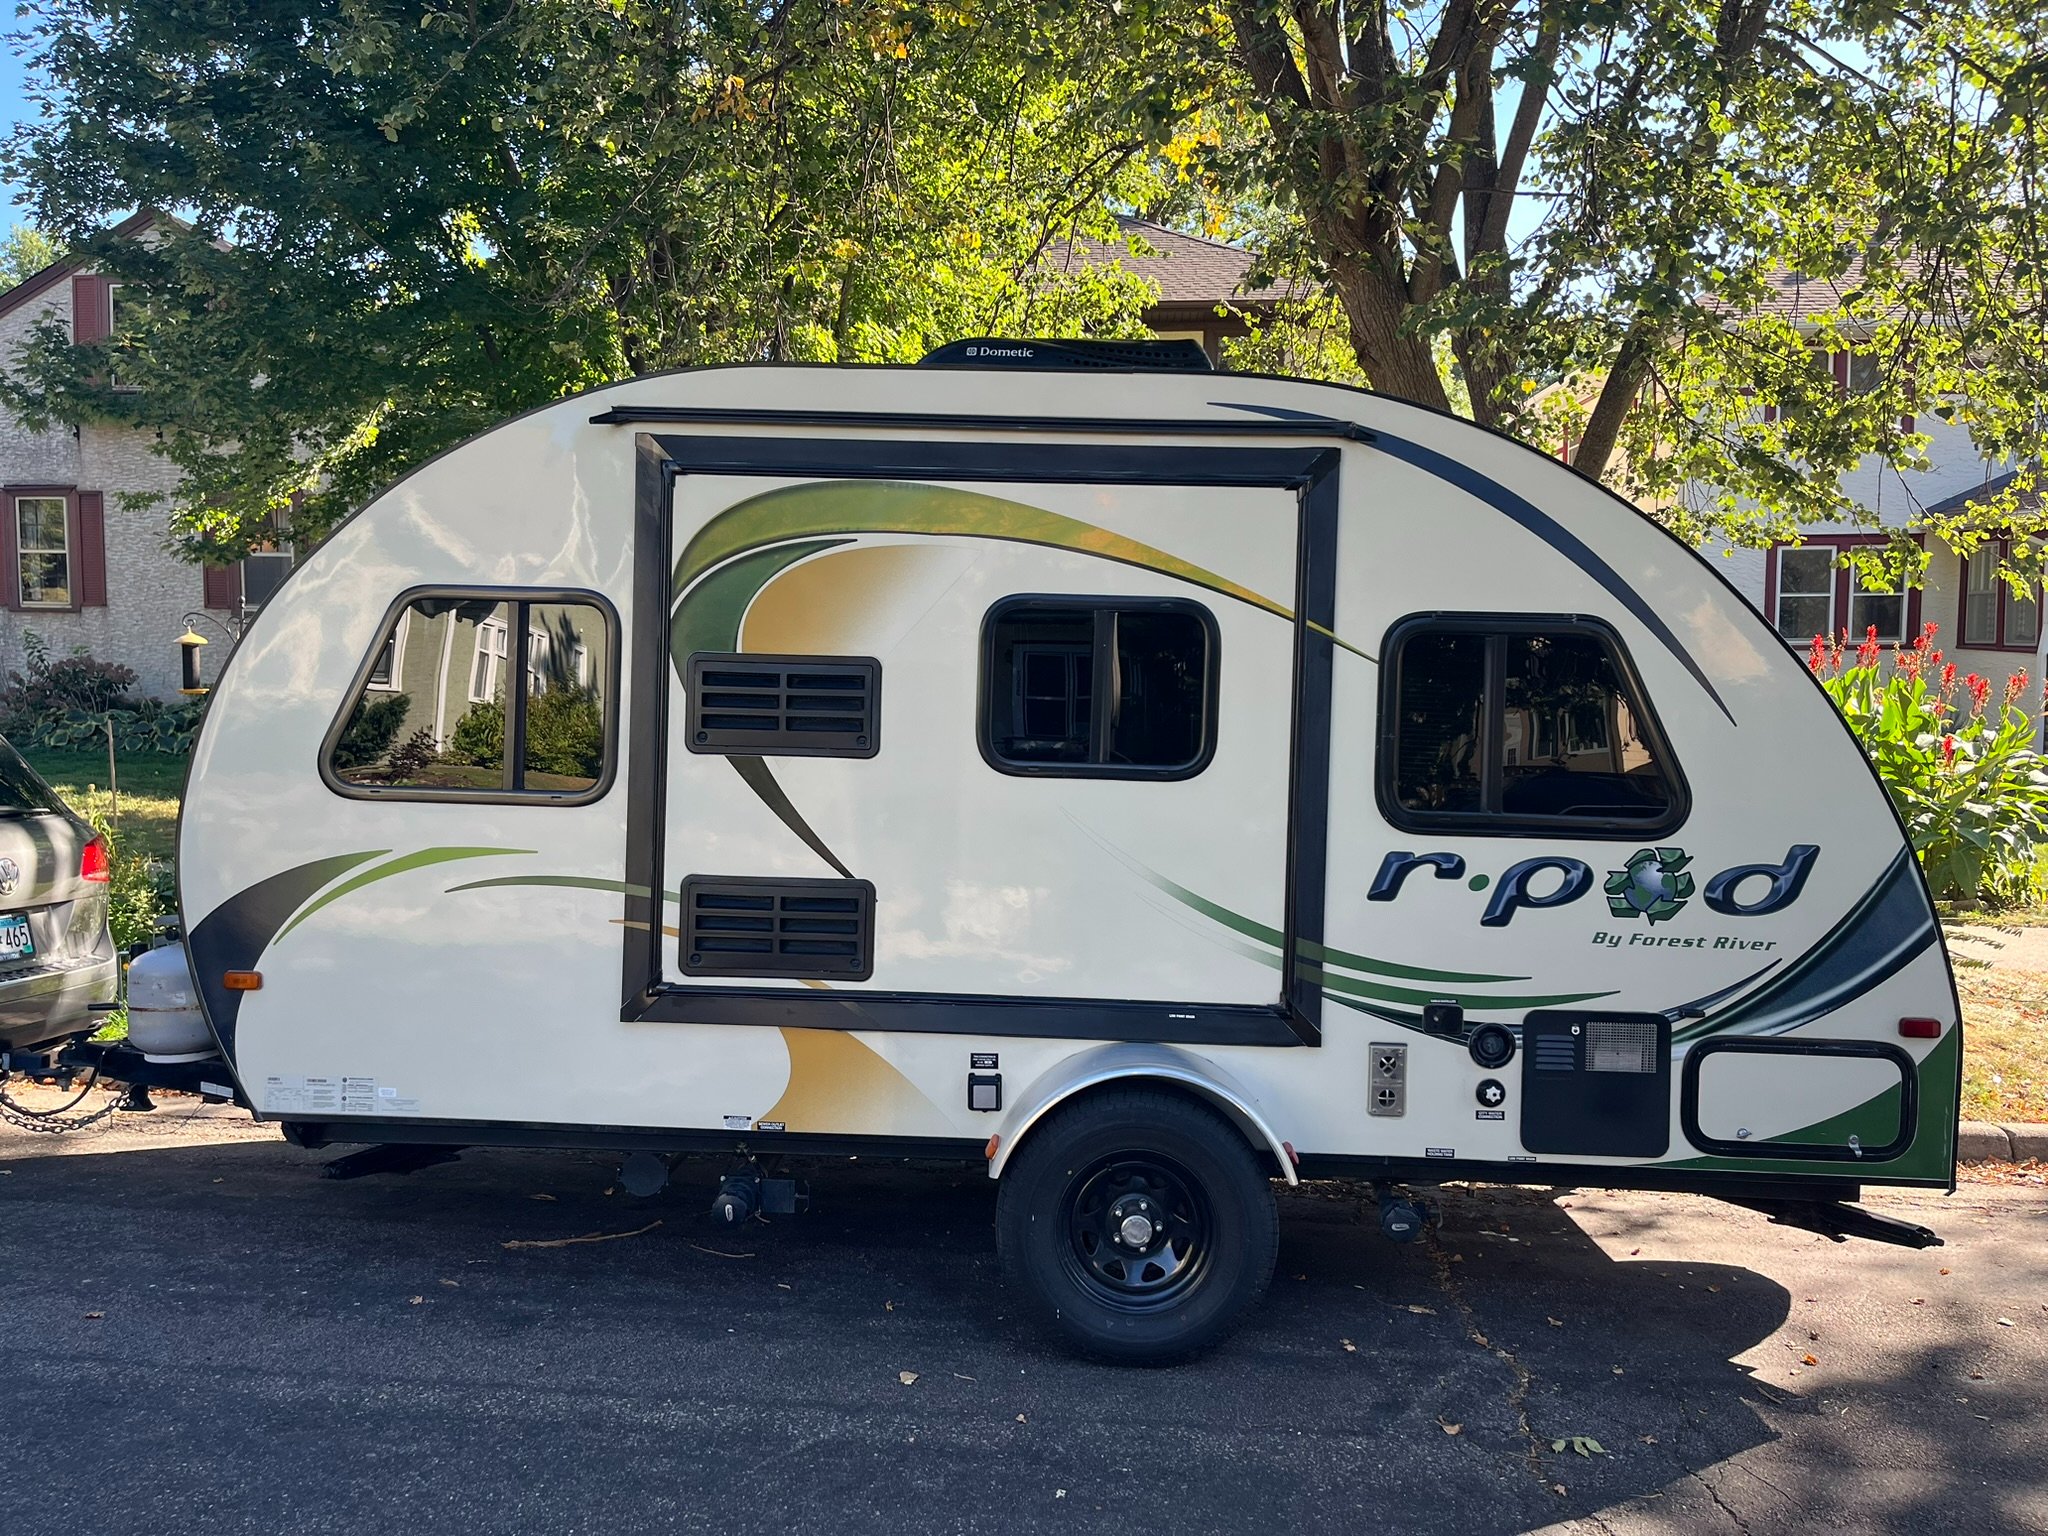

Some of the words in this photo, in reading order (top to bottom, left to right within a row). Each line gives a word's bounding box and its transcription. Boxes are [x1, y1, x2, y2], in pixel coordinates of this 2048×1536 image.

[980, 347, 1034, 357] Dometic
[6, 925, 30, 948] 465
[1592, 932, 1622, 947] By
[1629, 933, 1707, 948] Forest
[1713, 936, 1777, 951] River
